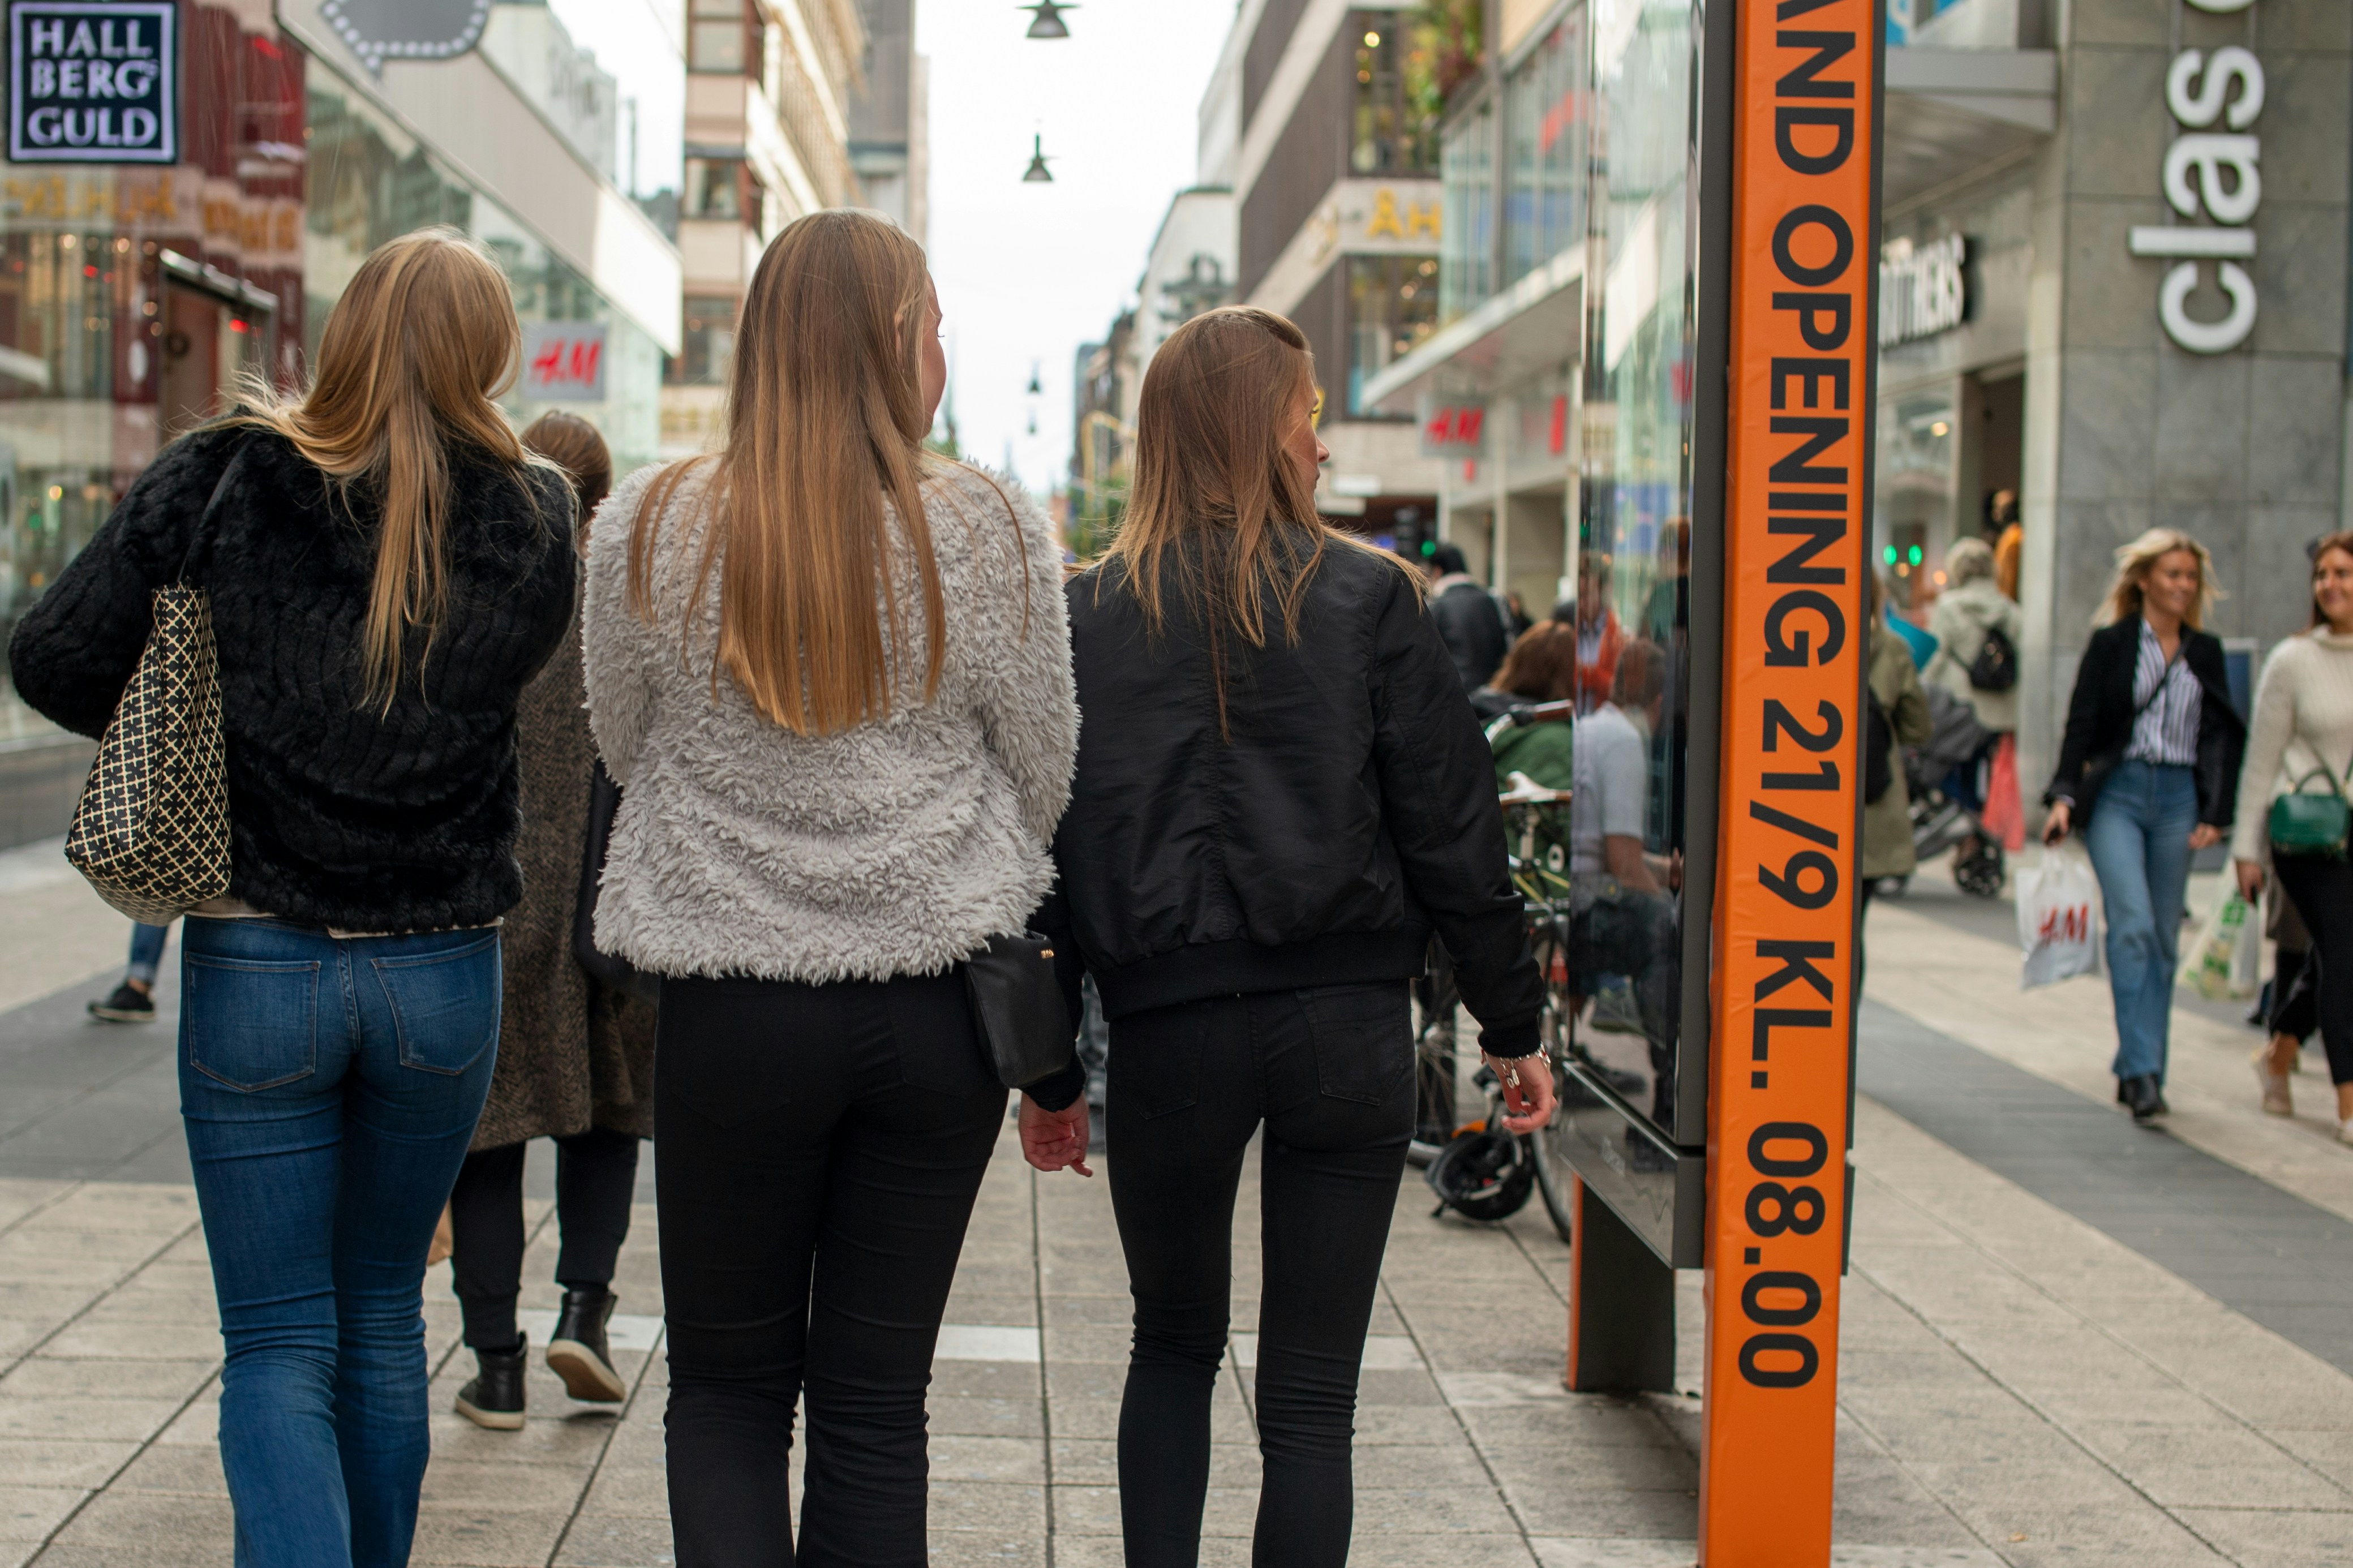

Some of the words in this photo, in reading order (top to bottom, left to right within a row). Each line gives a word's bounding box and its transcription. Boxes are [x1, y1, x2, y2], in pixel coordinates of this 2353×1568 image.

[28, 106, 158, 146] GULD
[31, 19, 153, 57] HALL
[2129, 46, 2264, 354] clas
[1764, 204, 1854, 668] OPENING
[1750, 699, 1843, 910] 21/9
[1751, 939, 1835, 1089] KL.
[1738, 1122, 1828, 1389] 08.00
